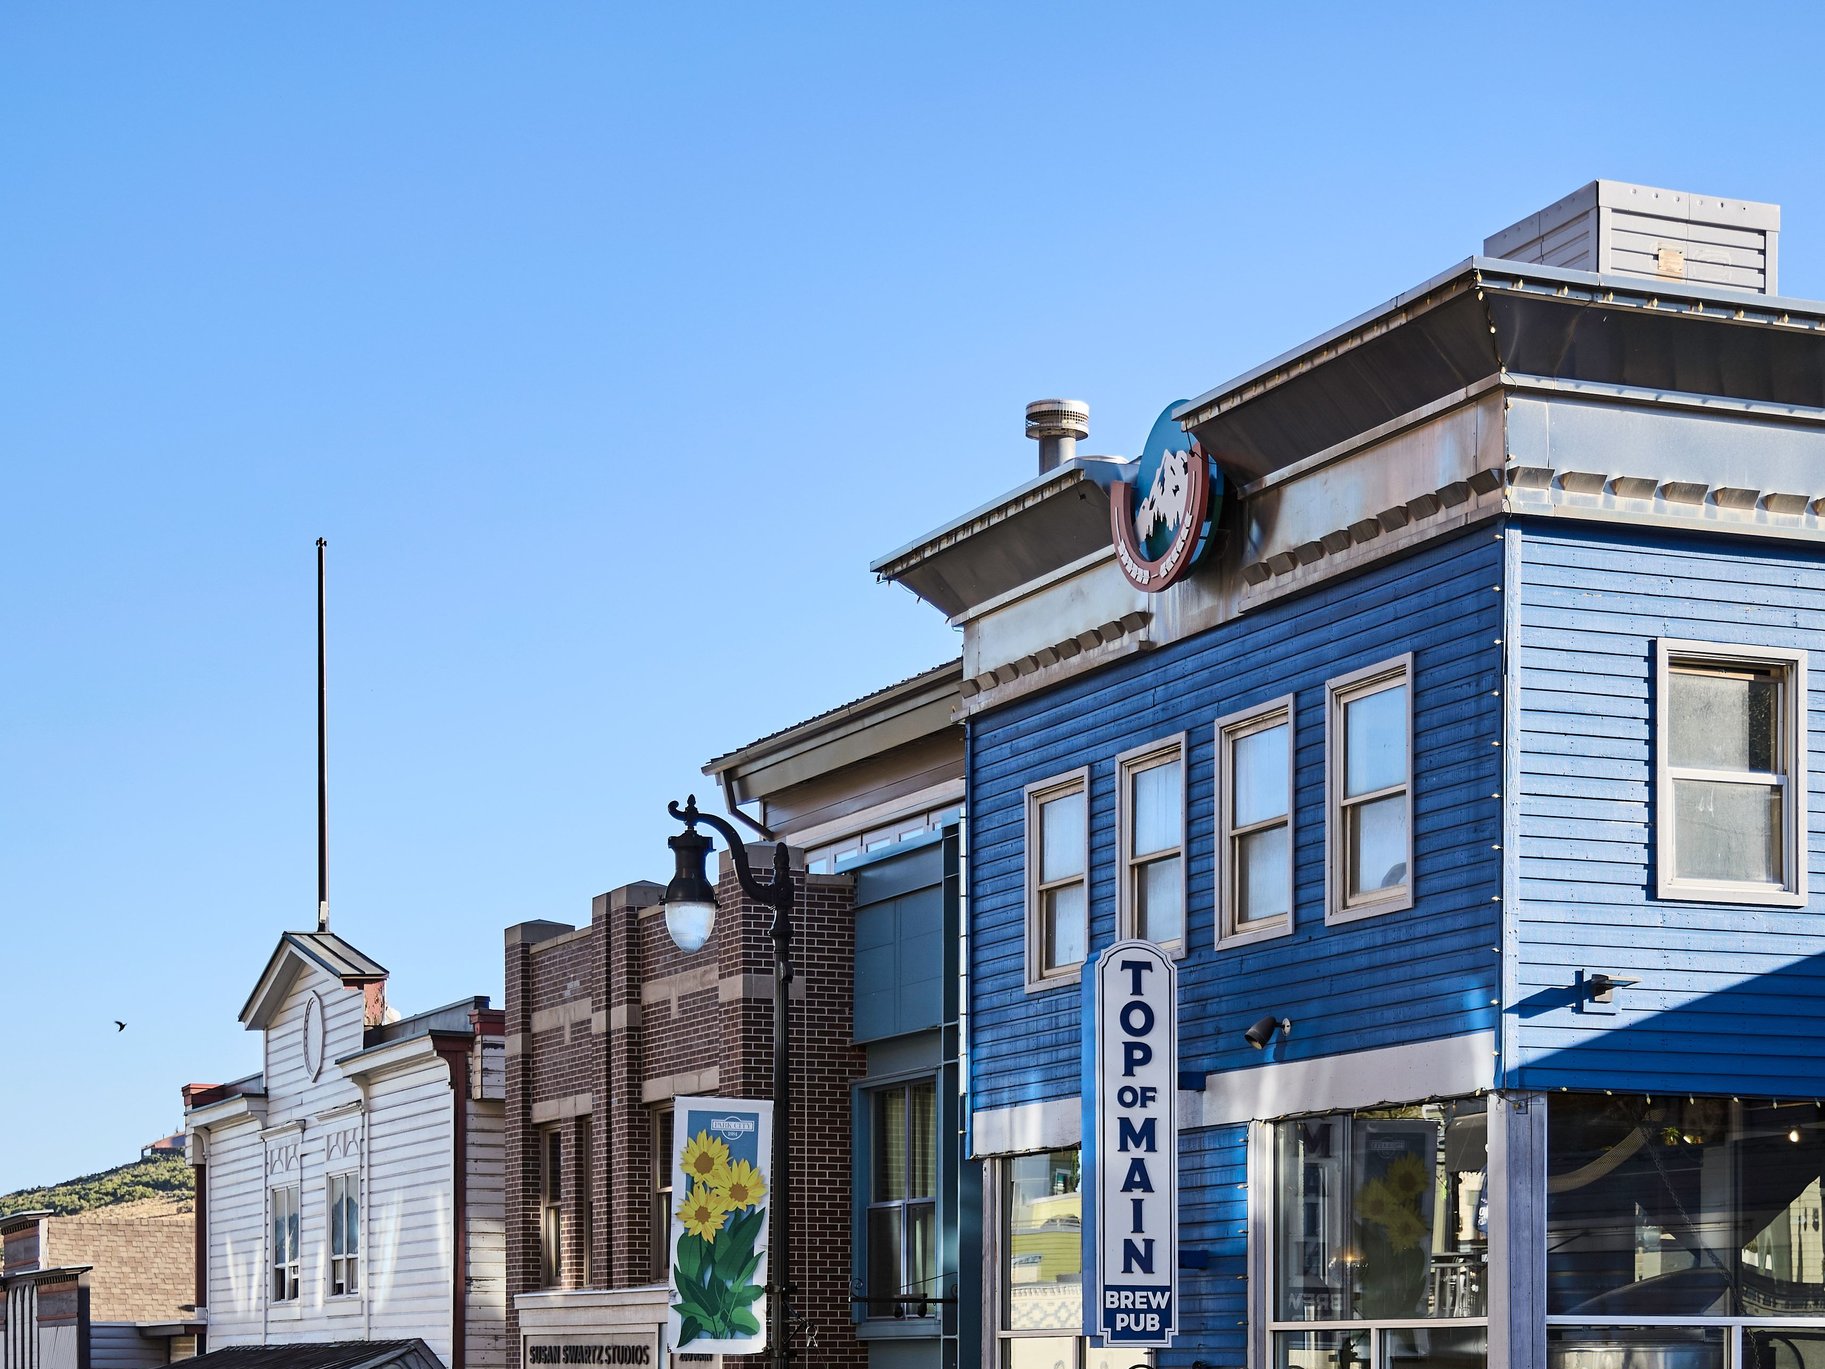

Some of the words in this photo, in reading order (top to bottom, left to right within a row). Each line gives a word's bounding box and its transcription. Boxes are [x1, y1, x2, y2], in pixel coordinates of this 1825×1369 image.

[1120, 960, 1155, 1077] TOP
[1117, 1085, 1157, 1109] OF
[1117, 1117, 1158, 1275] MAIN
[1105, 1290, 1170, 1310] BREW
[1115, 1314, 1161, 1333] PUB
[529, 1345, 561, 1365] SUSAN
[562, 1345, 604, 1365] SWARTZ
[605, 1345, 650, 1365] STUDIOS
